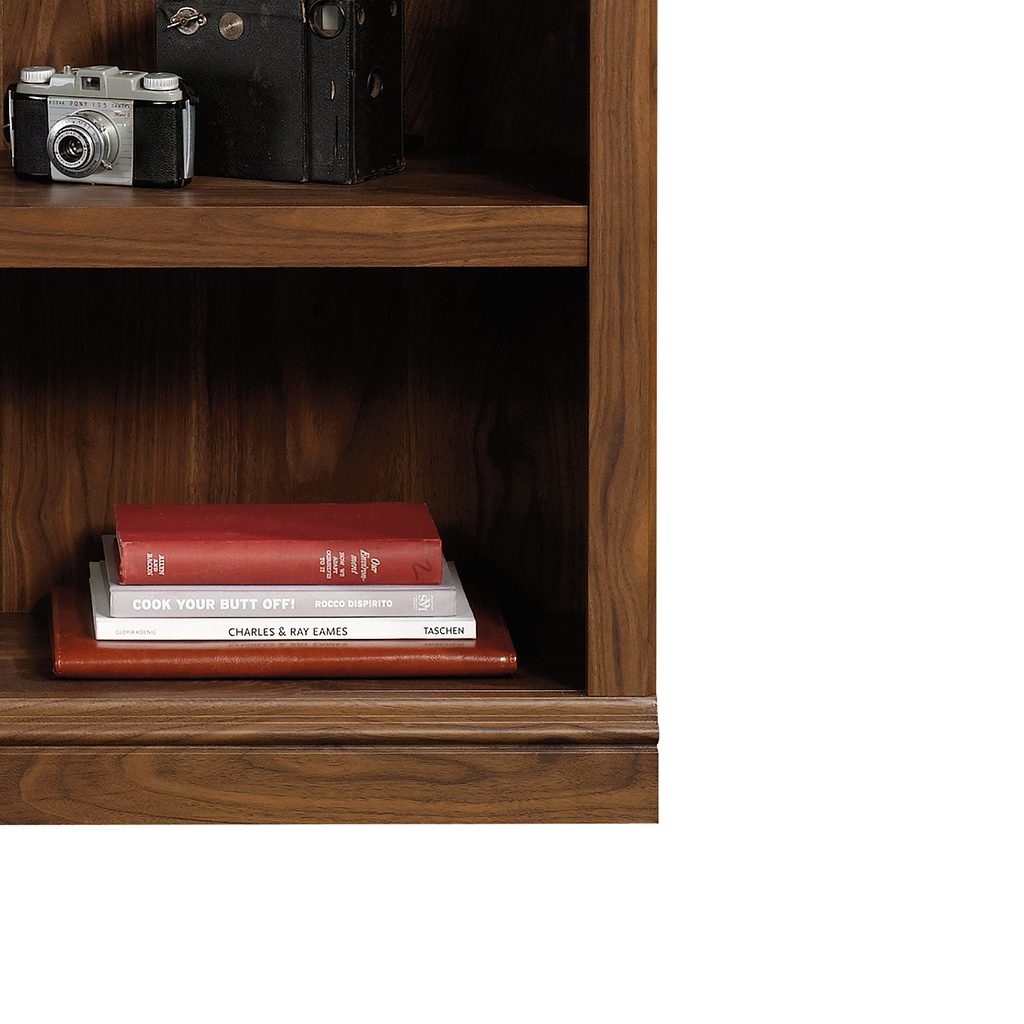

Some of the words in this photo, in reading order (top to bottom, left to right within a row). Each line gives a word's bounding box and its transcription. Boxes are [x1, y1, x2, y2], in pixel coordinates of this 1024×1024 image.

[320, 557, 325, 565] TO
[360, 549, 370, 581] Environ-
[371, 557, 380, 573] Our
[132, 599, 172, 611] COOK
[176, 599, 215, 610] YOUR
[220, 598, 259, 610] BUTT
[262, 598, 296, 610] OFF!
[314, 600, 345, 608] ROCCO
[347, 599, 393, 608] DISPIRITO
[228, 627, 275, 637] CHARLES
[278, 626, 287, 636] &
[290, 627, 309, 636] RAY
[313, 627, 348, 636] EAMES
[423, 626, 465, 635] TASCHEN
